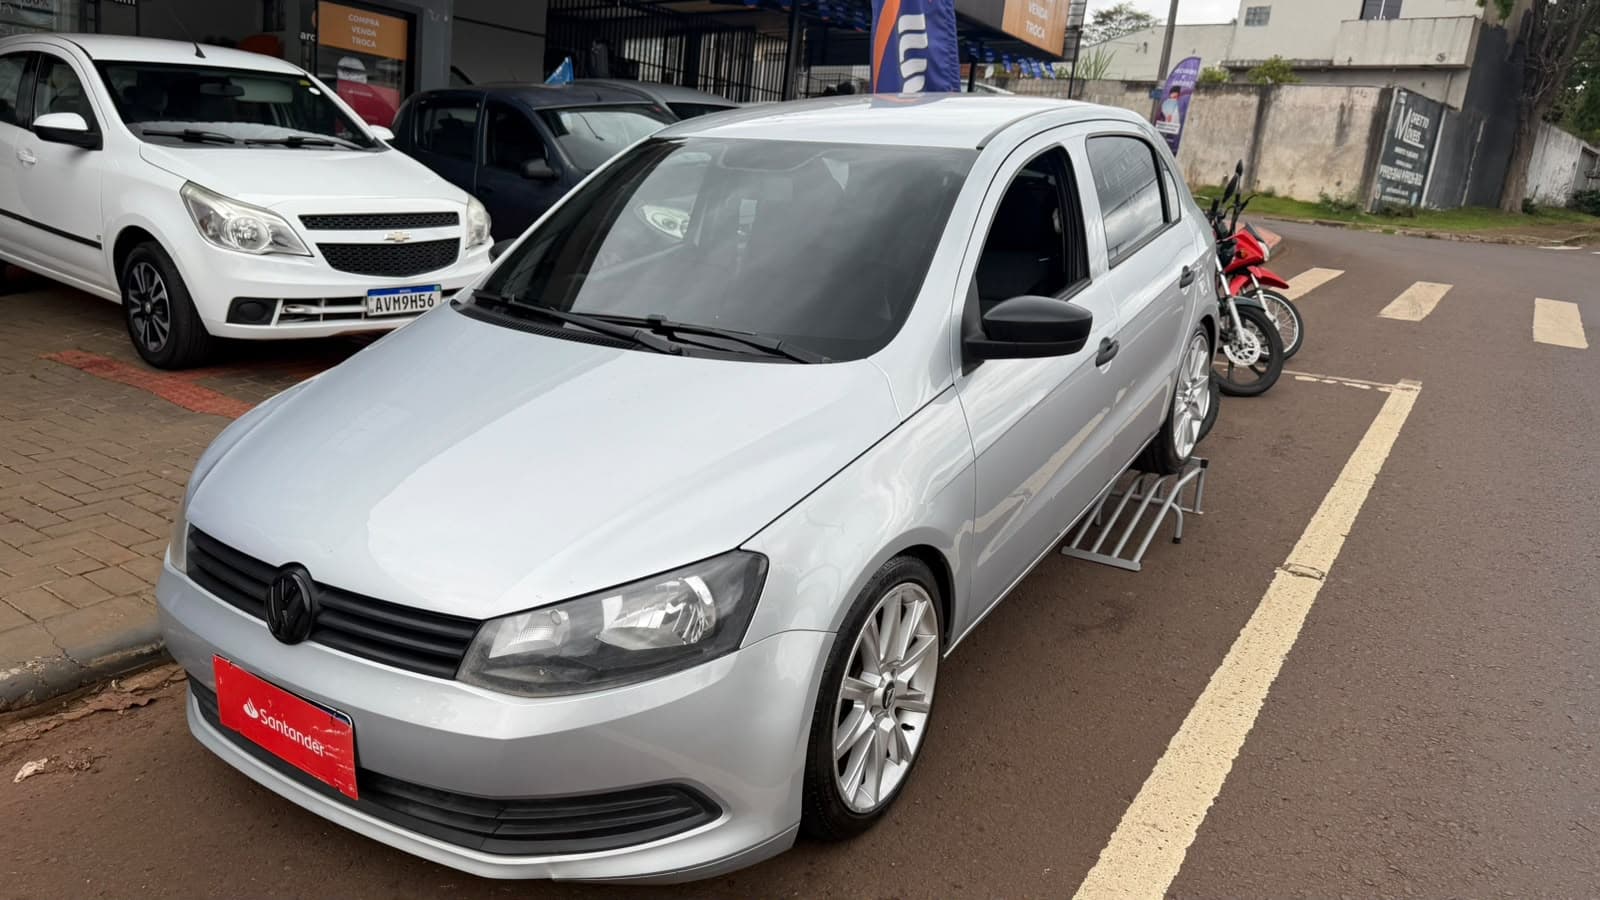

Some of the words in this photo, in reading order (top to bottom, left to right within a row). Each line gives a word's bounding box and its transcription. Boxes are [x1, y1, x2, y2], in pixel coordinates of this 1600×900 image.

[348, 14, 380, 27] COMPRA
[351, 25, 377, 37] VENDA
[1025, 20, 1046, 39] TROCA
[351, 36, 377, 48] TROCA
[375, 293, 434, 313] AVM9H56
[259, 708, 325, 757] Santander
